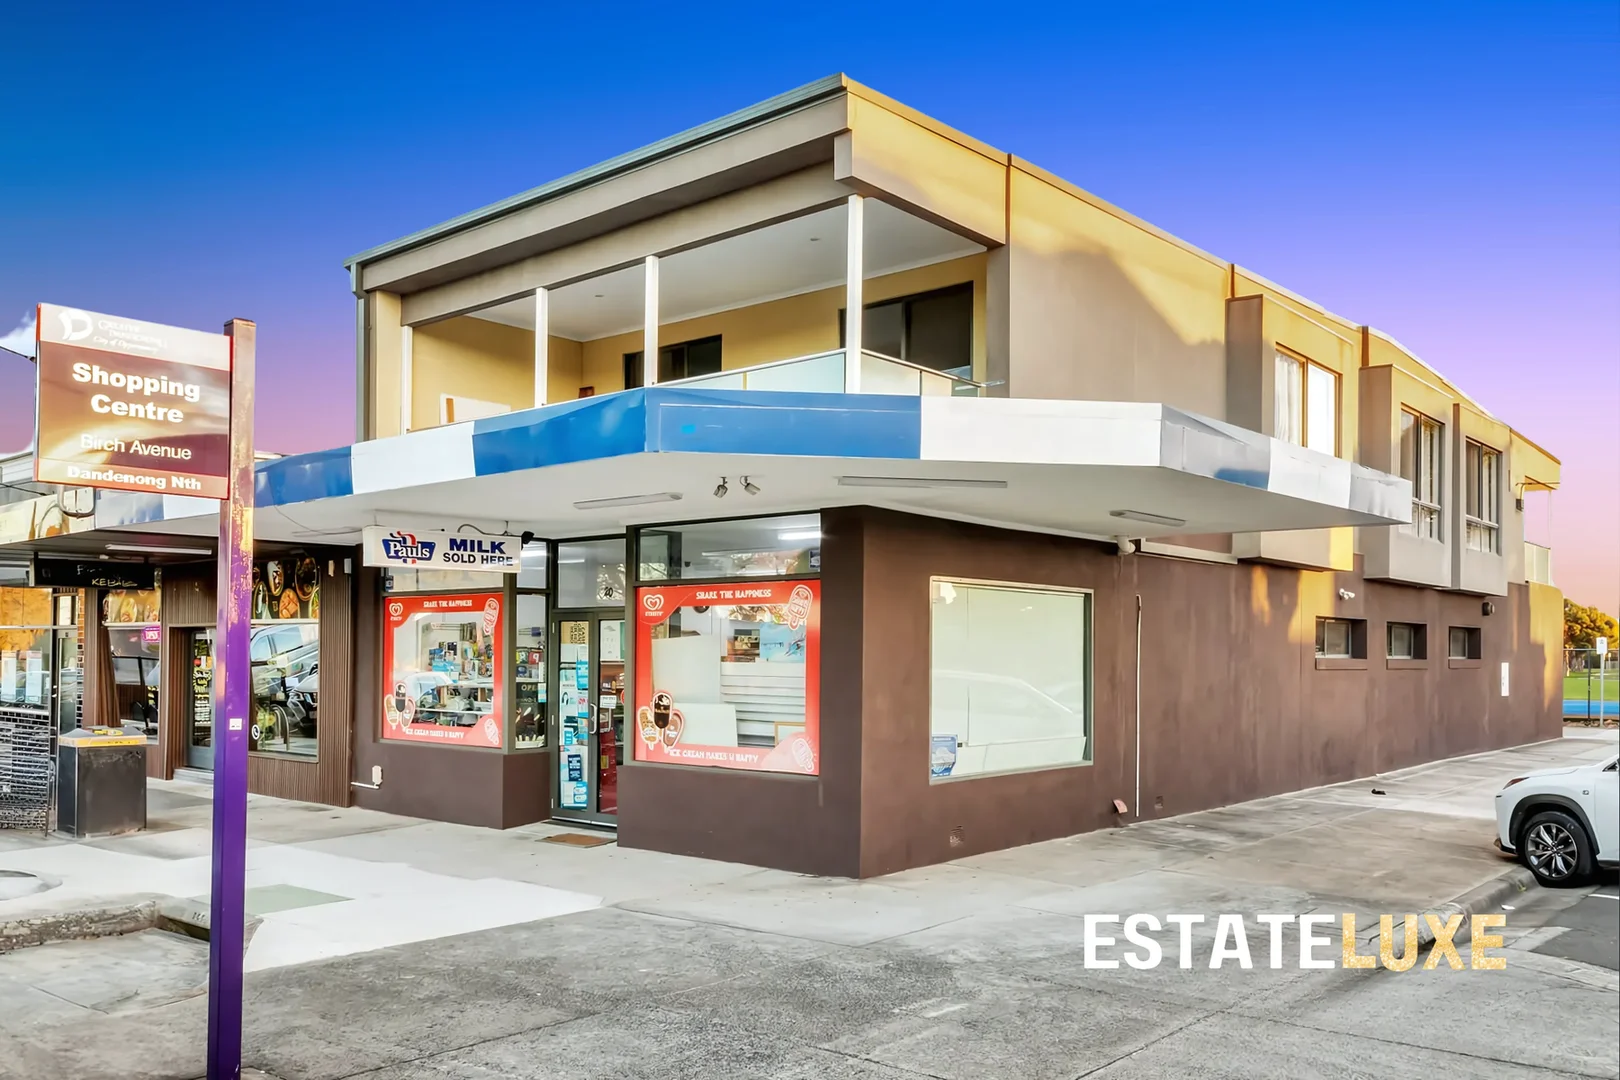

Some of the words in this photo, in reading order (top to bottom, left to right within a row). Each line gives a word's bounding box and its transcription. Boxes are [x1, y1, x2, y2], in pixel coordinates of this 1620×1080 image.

[72, 362, 200, 402] Shopping
[90, 394, 184, 423] Centre
[80, 434, 125, 453] Birch
[129, 440, 192, 460] Avenue
[67, 465, 167, 489] Dandenong
[171, 475, 202, 490] Nth
[388, 540, 431, 559] Pauls
[449, 537, 507, 555] MILK
[443, 552, 476, 564] SOLD
[481, 555, 514, 566] HERE
[696, 591, 718, 600] SHARE
[720, 590, 734, 599] THE
[735, 589, 772, 599] HAPPINESS
[683, 749, 705, 759] CREAM
[736, 753, 759, 764] HAPPY
